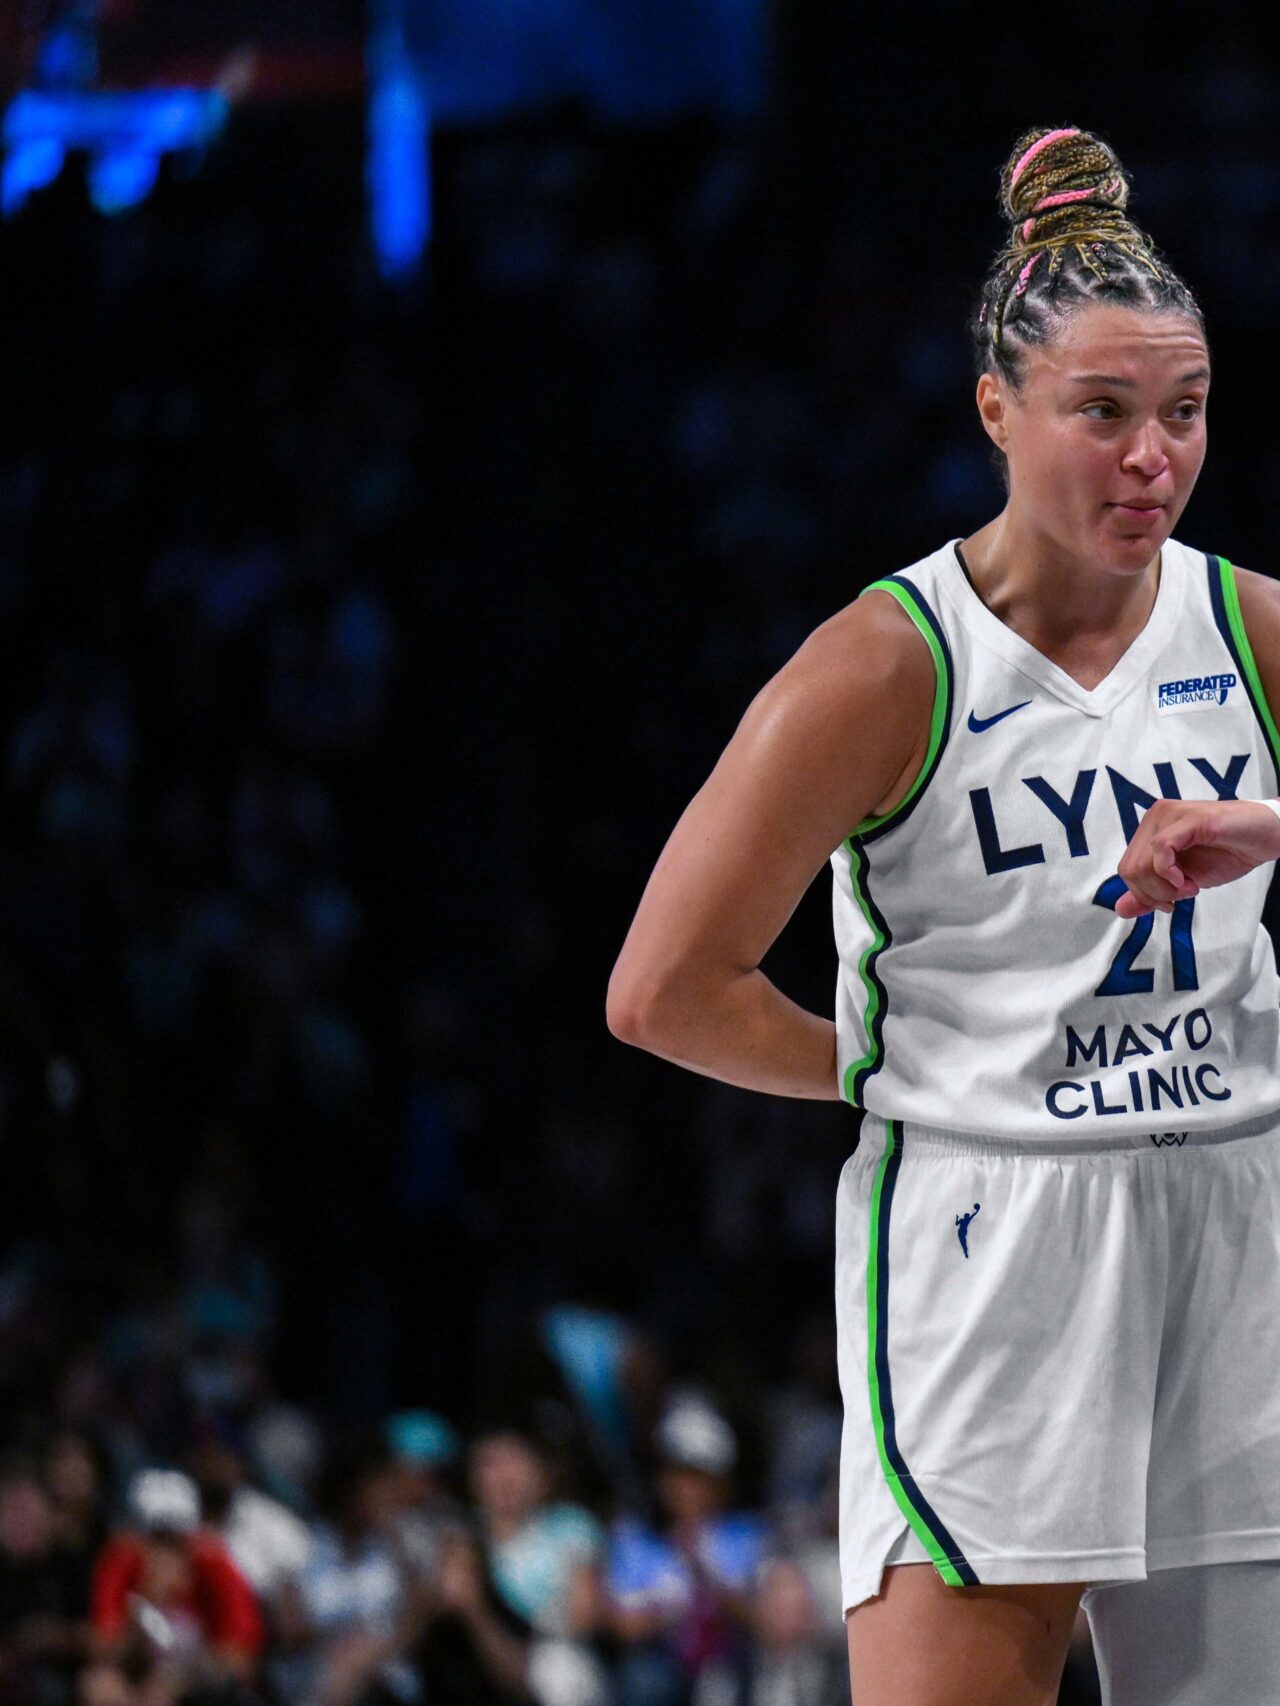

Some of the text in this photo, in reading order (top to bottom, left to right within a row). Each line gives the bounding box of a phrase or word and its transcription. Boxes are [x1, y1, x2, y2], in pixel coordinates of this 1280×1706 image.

[1158, 673, 1237, 698] FEDERATED
[1158, 690, 1214, 709] INSURANCE
[1092, 873, 1200, 997] 21
[1065, 1007, 1212, 1068] MAYO
[1045, 1063, 1232, 1119] CLINIC
